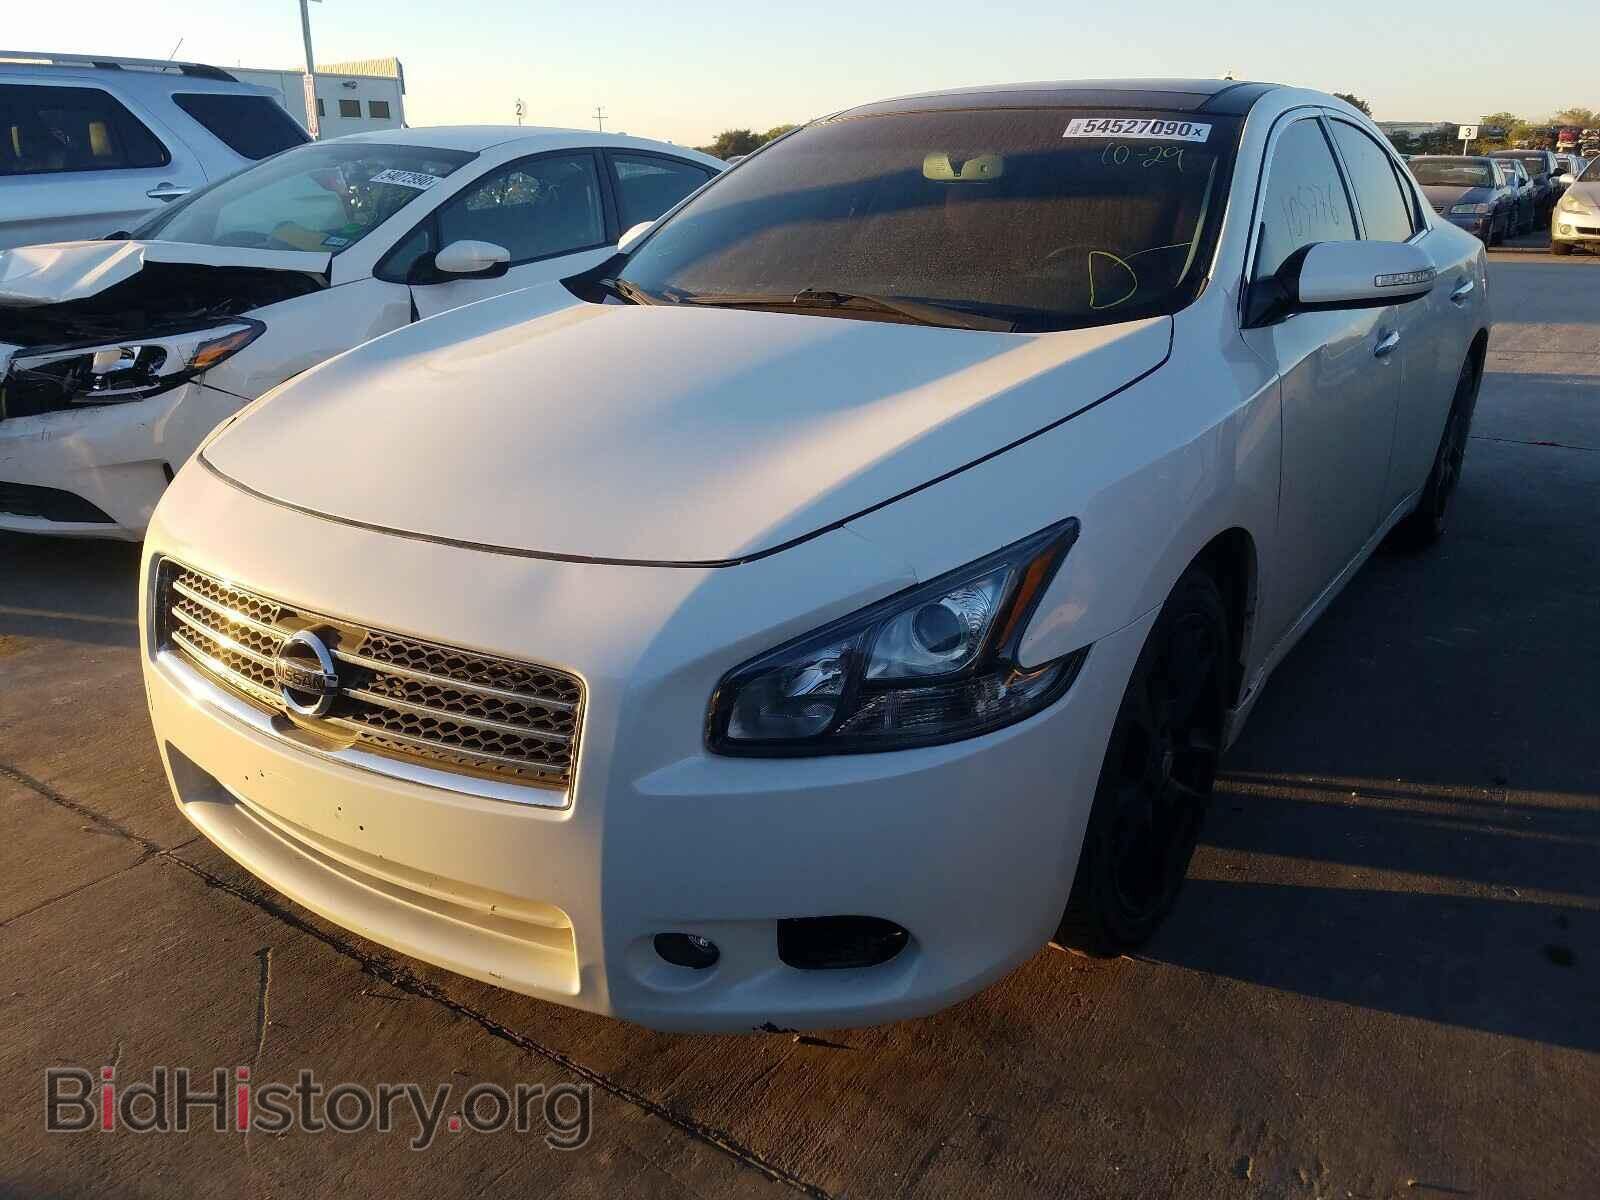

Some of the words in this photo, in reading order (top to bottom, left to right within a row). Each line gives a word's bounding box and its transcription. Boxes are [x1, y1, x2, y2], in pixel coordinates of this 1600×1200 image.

[515, 103, 523, 116] 2
[1464, 127, 1472, 138] 3
[275, 660, 325, 691] NISSAN
